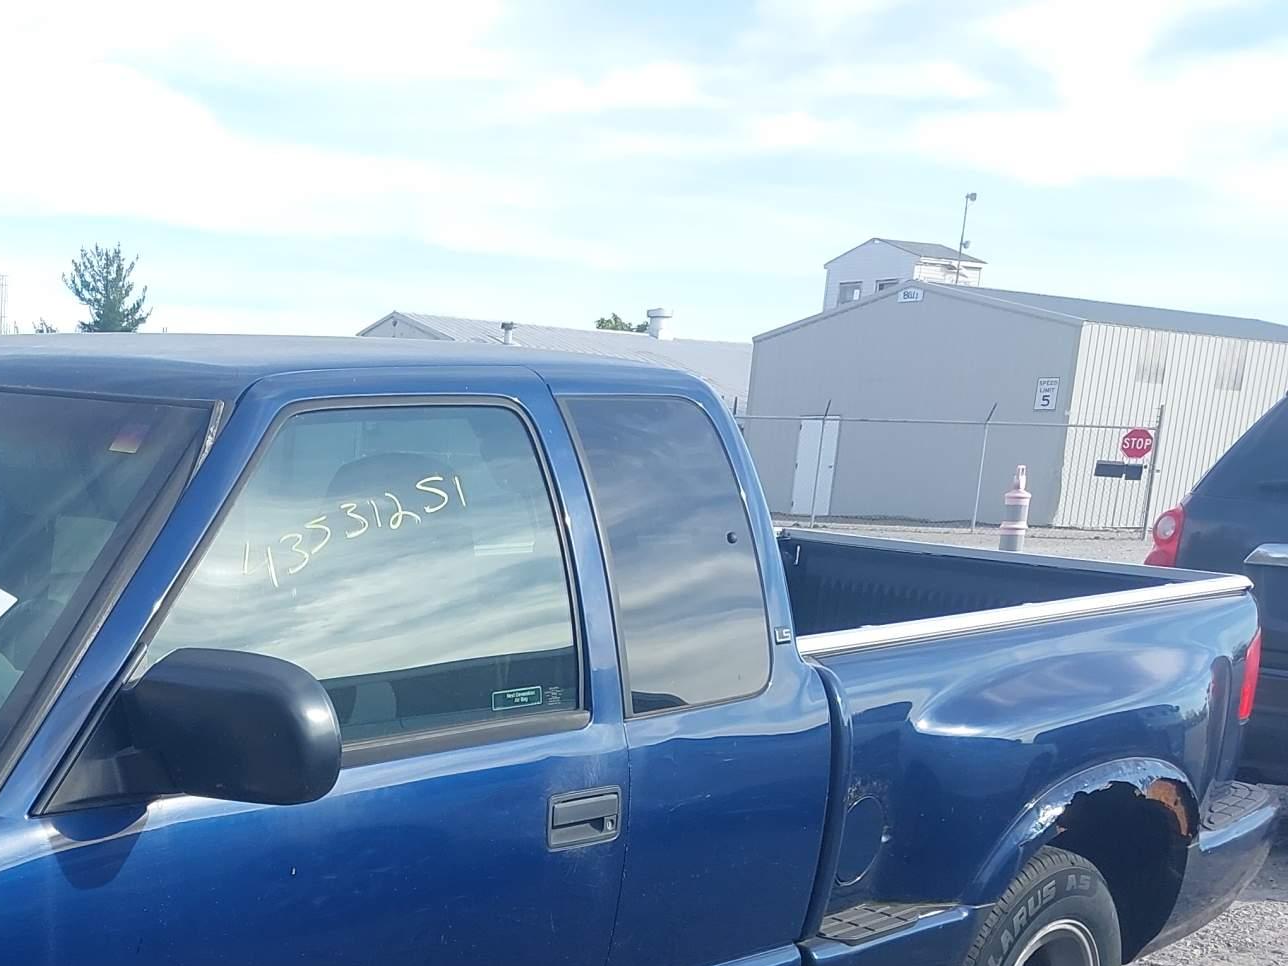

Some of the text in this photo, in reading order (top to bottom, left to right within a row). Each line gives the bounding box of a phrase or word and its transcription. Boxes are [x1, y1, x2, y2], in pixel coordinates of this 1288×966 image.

[1041, 394, 1051, 407] 5
[1122, 437, 1152, 449] STOP
[241, 476, 467, 587] 43531251
[775, 628, 792, 643] LS
[1065, 873, 1091, 892] AS
